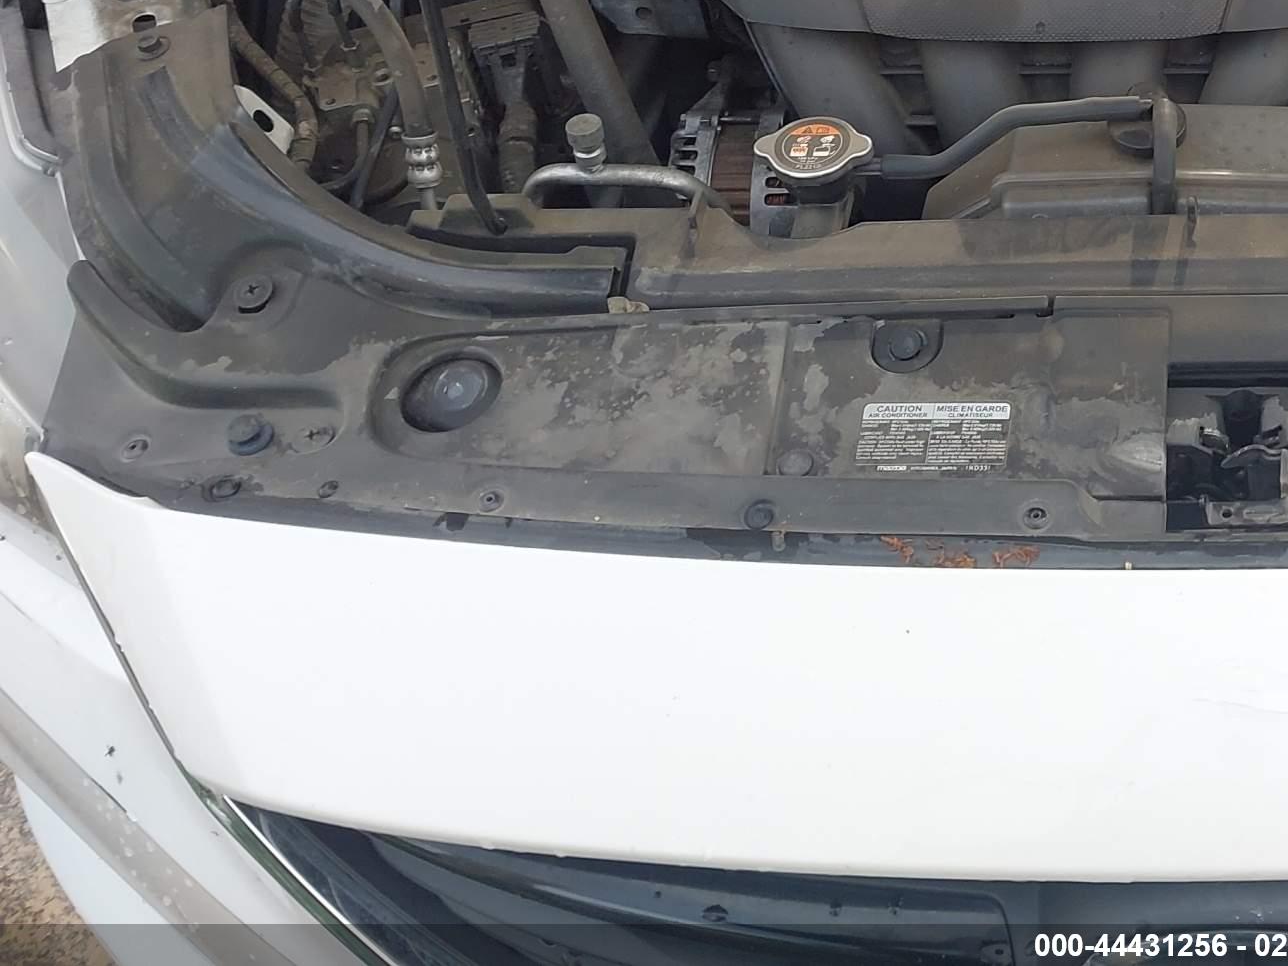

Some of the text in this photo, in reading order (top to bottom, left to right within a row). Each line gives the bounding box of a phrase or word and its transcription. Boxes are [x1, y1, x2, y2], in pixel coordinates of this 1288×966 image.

[876, 405, 922, 413] CAUTION
[936, 405, 1008, 413] MISE EN GARDE
